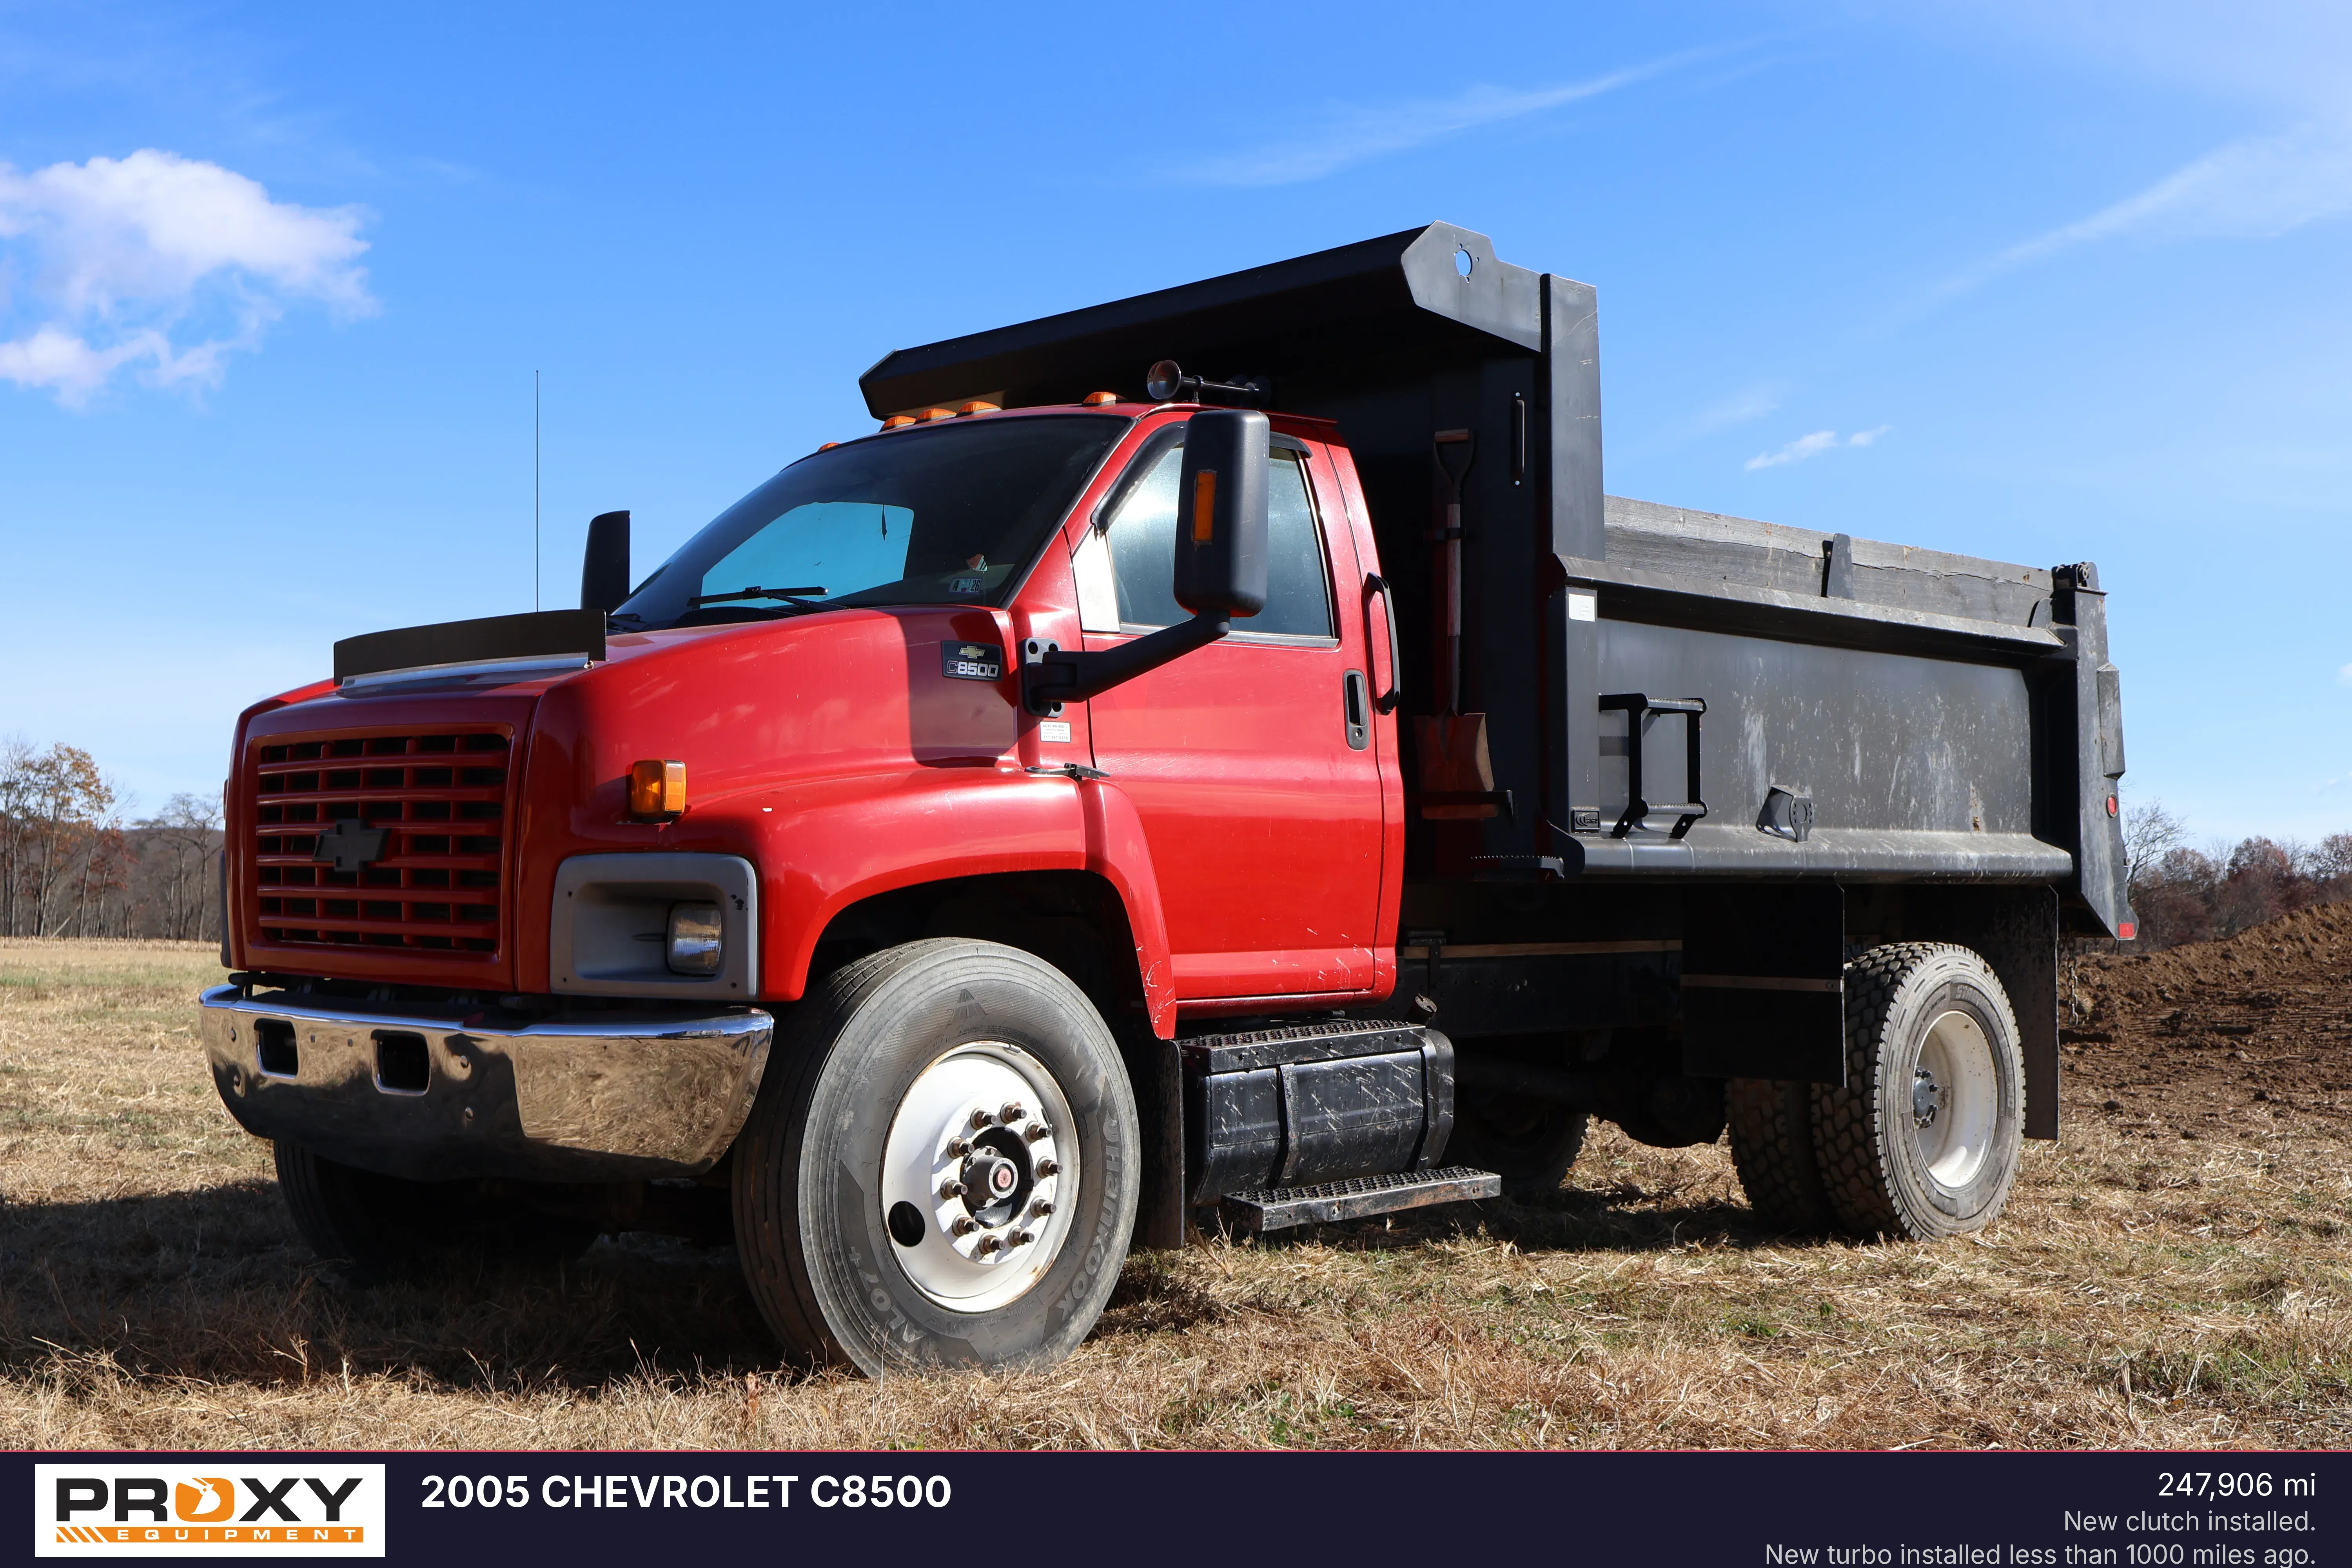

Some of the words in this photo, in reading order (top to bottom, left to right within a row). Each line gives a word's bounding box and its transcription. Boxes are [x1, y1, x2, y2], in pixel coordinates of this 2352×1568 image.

[953, 580, 960, 591] 4
[971, 579, 980, 591] 26
[946, 660, 999, 677] C8500
